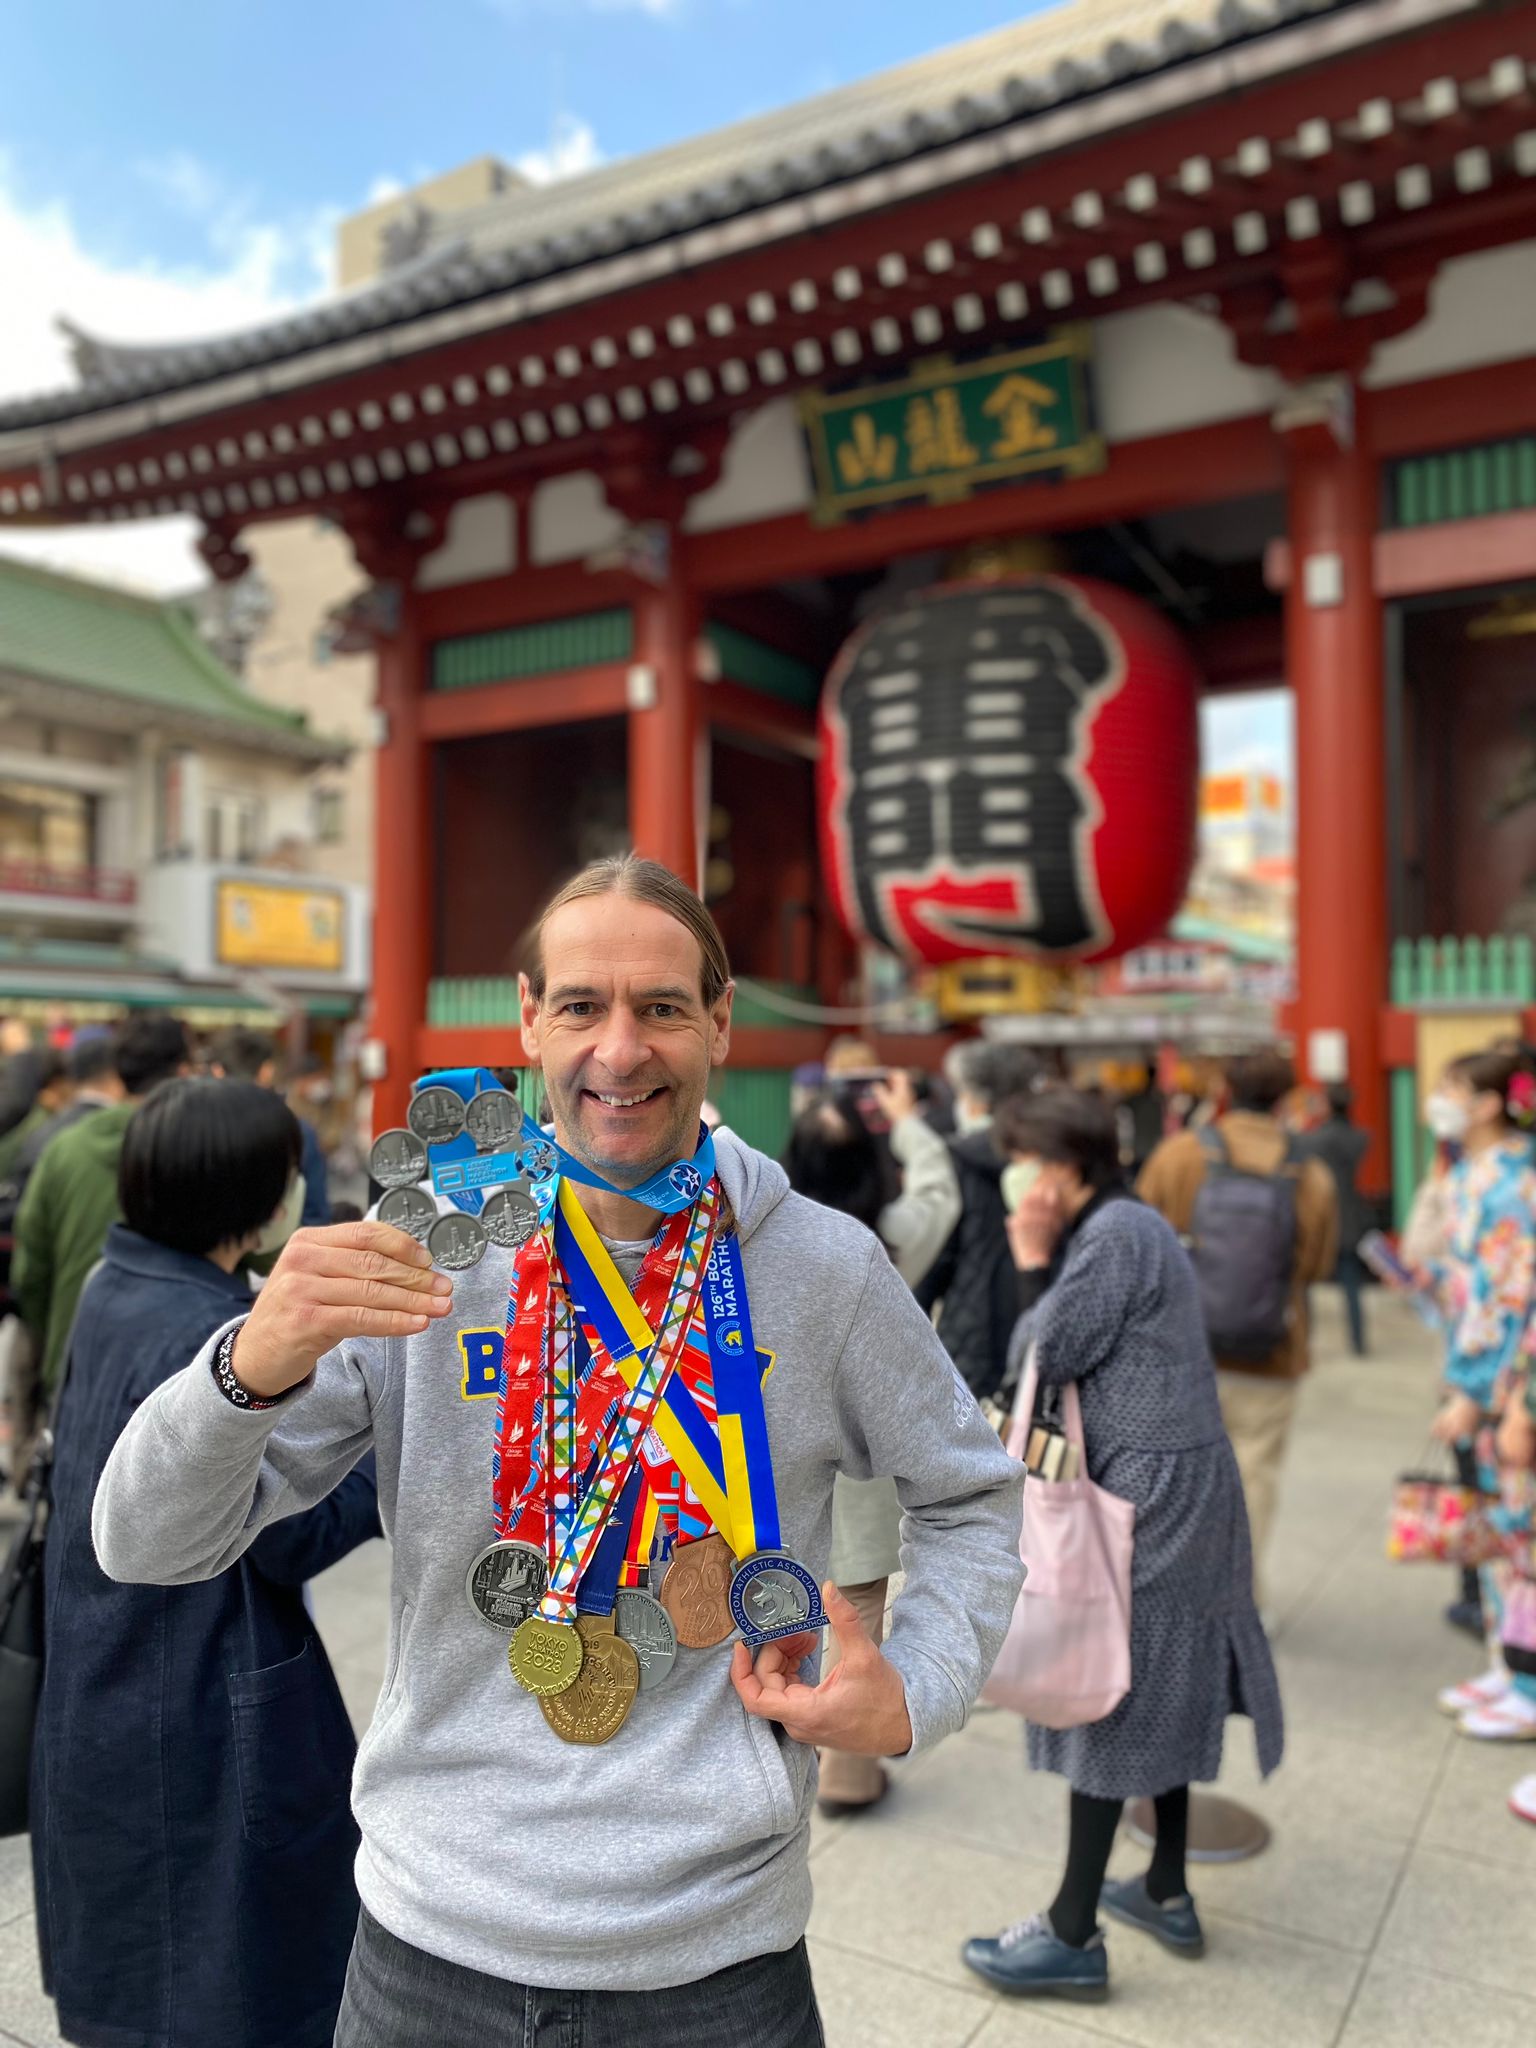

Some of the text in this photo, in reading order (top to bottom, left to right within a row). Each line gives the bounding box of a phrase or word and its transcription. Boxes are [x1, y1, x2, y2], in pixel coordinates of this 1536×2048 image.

[690, 1174, 697, 1184] 6
[730, 1560, 821, 1634] BOSTON ATHLETIC ASSOCIATION
[757, 1624, 787, 1643] BOSTON
[786, 1615, 828, 1634] MARATHON
[528, 1643, 567, 1660] MARATHON
[530, 1631, 568, 1652] TOKYO
[582, 1640, 600, 1650] 019
[522, 1649, 563, 1675] 2023
